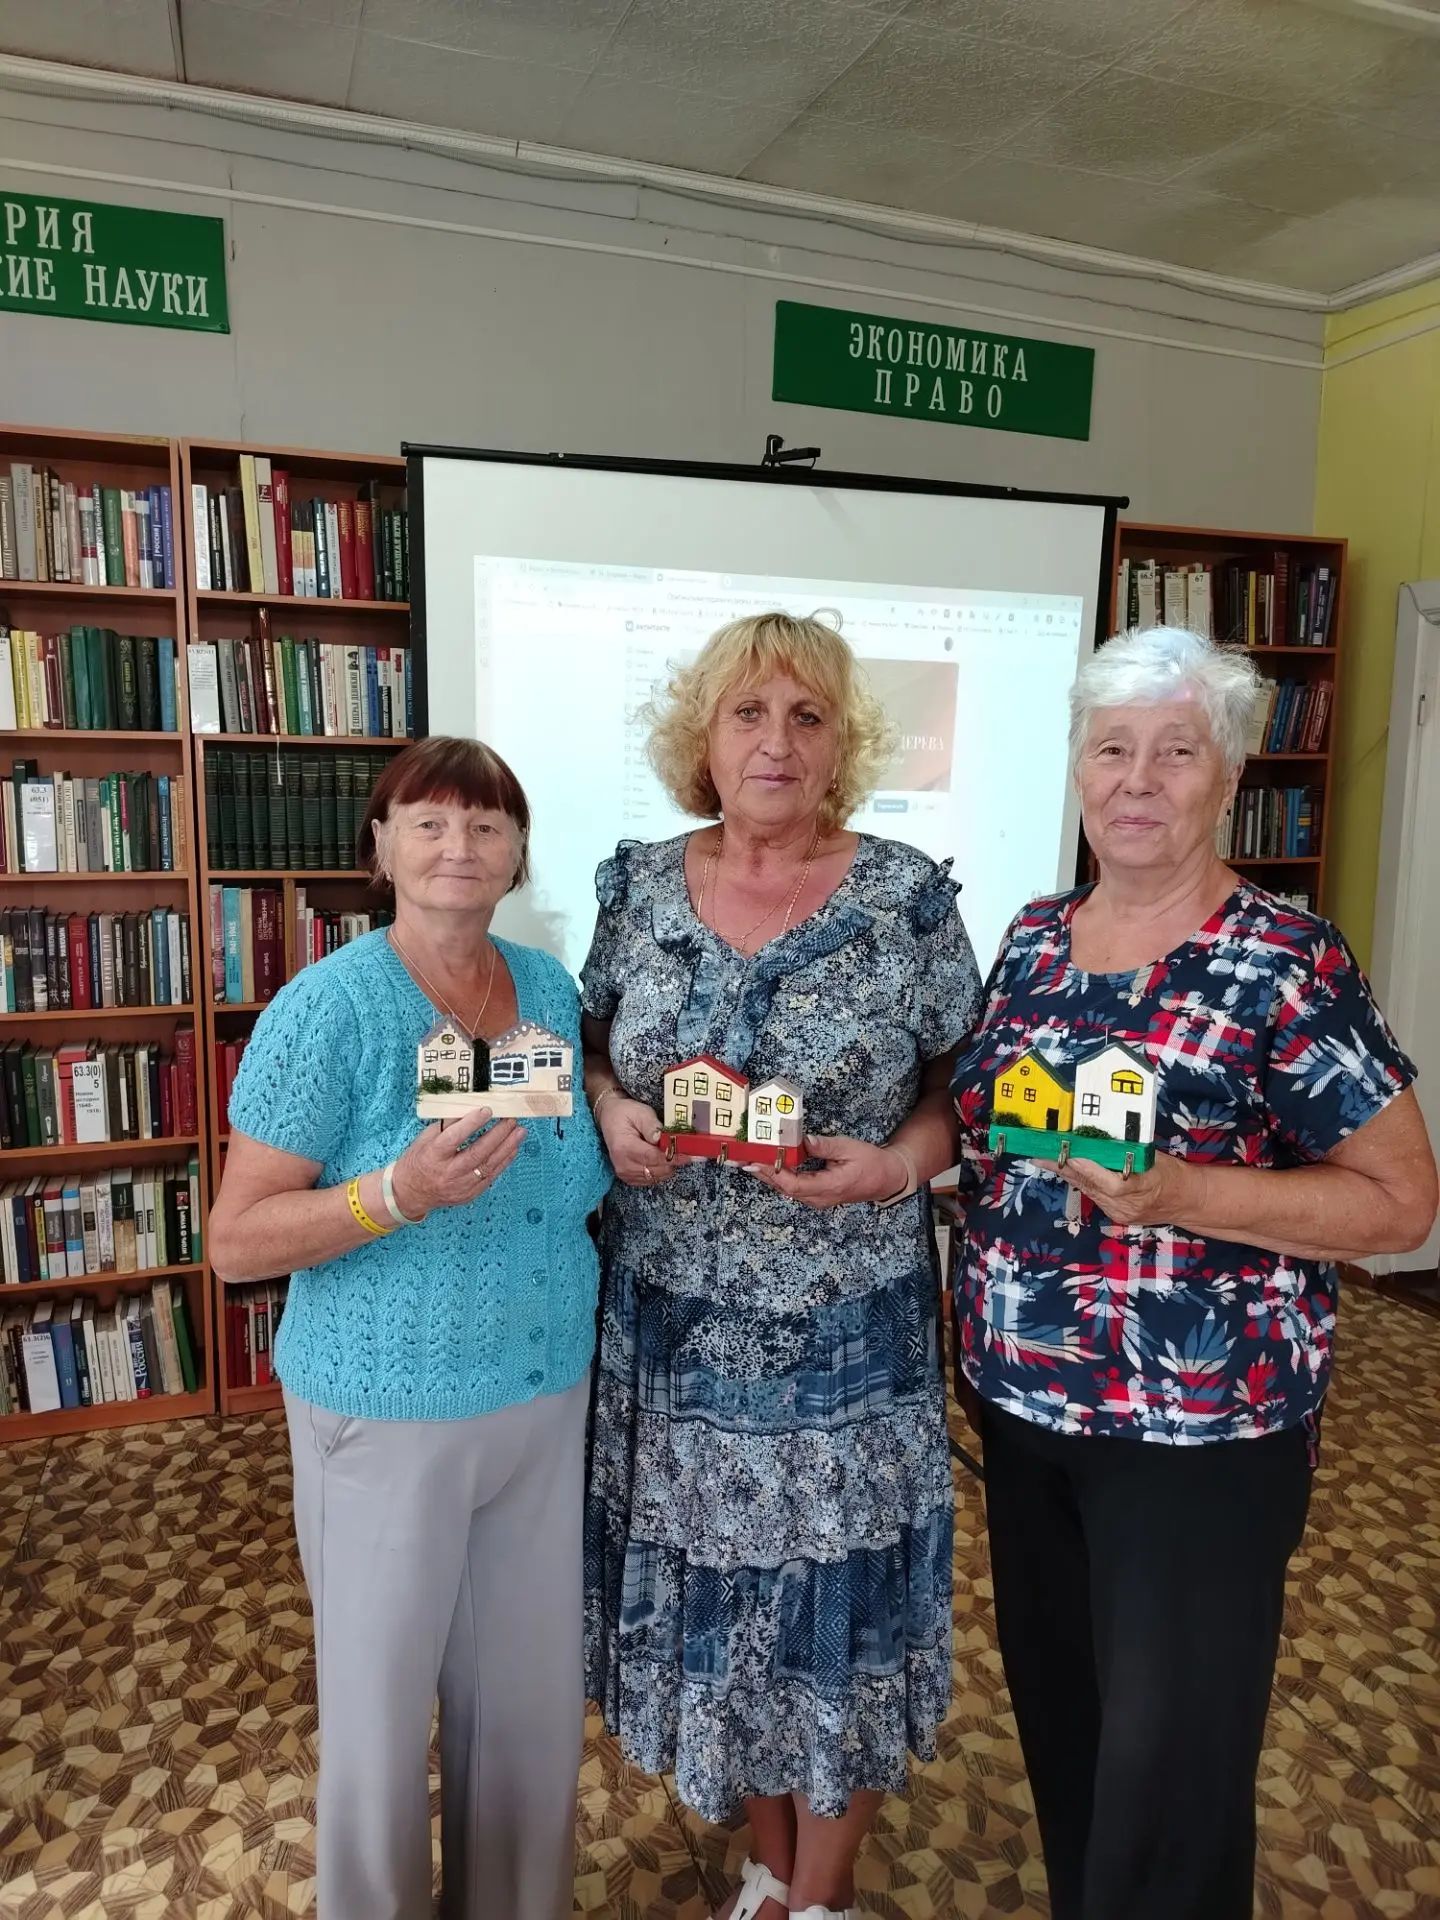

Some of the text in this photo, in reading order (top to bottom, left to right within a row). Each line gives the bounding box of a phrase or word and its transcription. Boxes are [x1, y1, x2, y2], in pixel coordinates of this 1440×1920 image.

[4, 202, 96, 254] РИЯ
[0, 254, 209, 318] ИЕ НАУКИ
[849, 322, 1028, 382] ЭКОНОМИКА
[874, 368, 1002, 418] ПРАВО
[74, 1064, 101, 1079] 63.3(0)
[93, 1079, 100, 1089] 5
[134, 1341, 148, 1378] Россия
